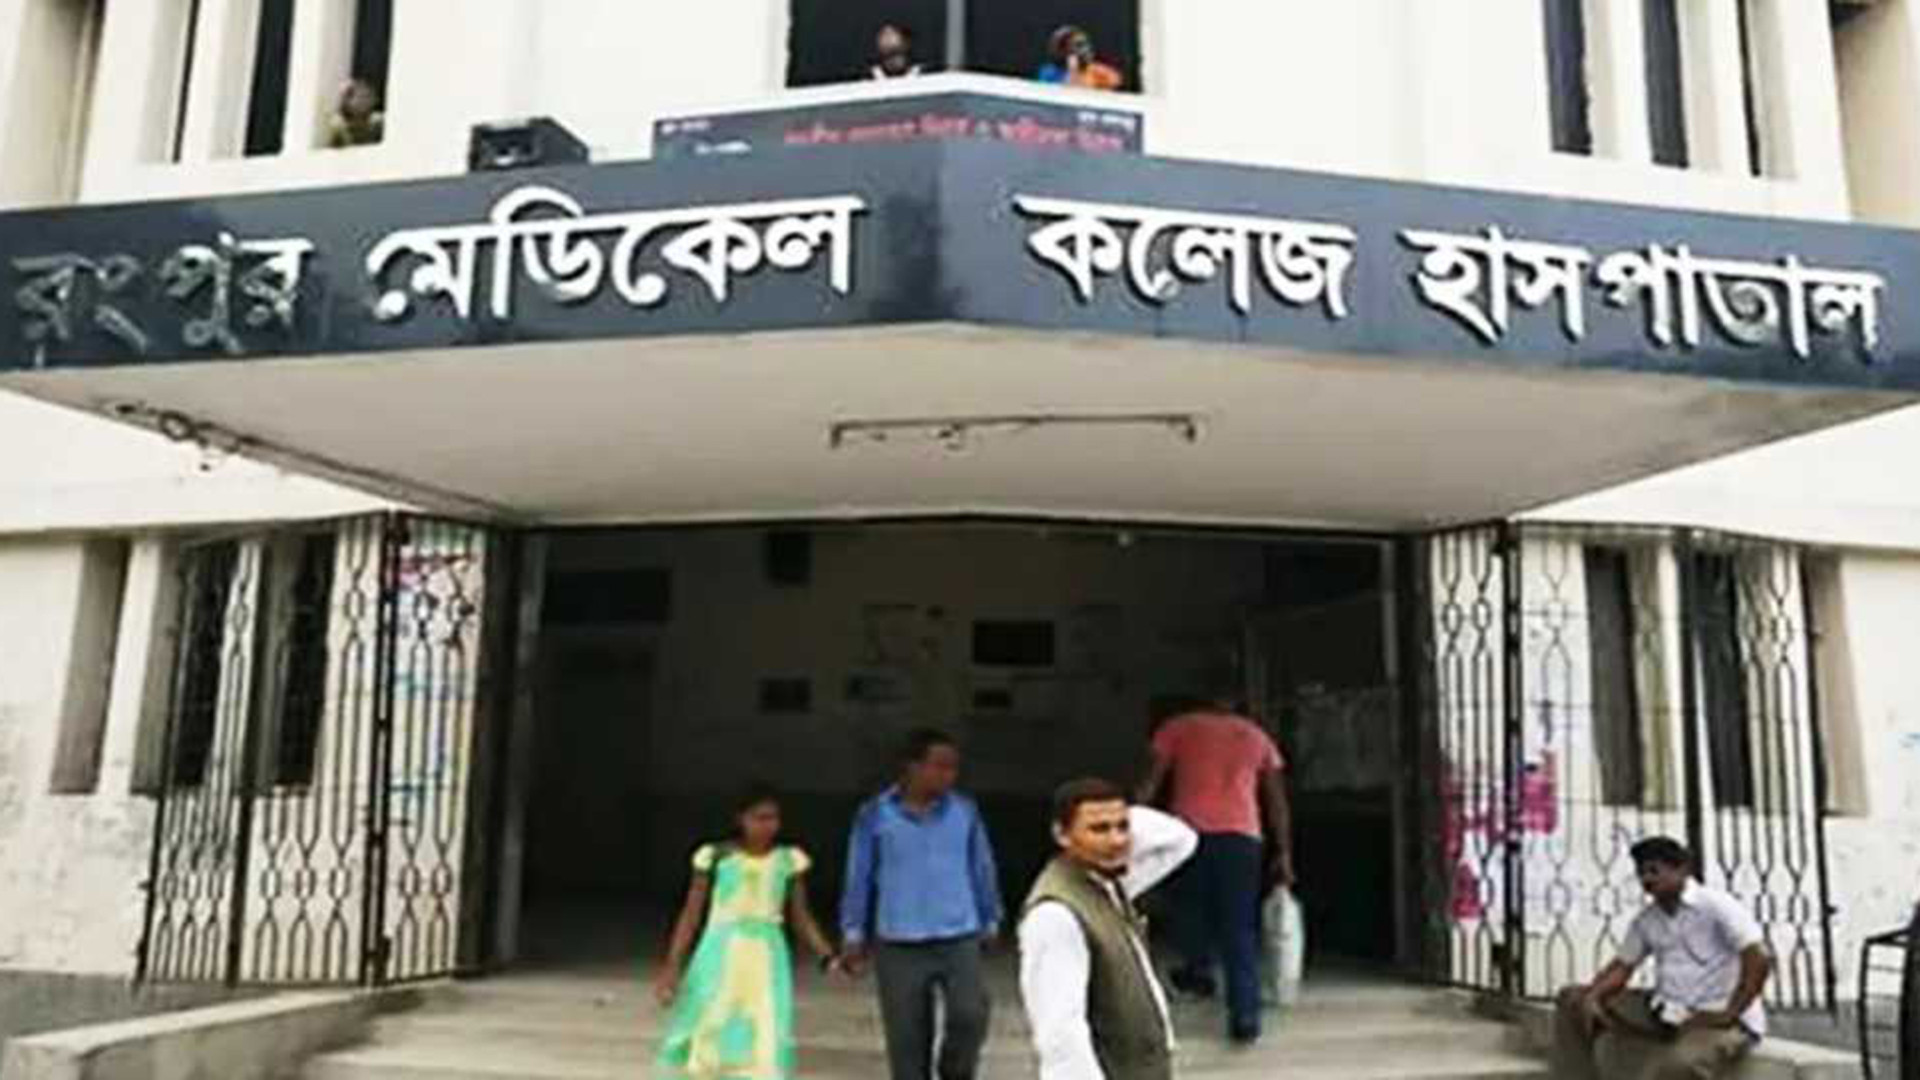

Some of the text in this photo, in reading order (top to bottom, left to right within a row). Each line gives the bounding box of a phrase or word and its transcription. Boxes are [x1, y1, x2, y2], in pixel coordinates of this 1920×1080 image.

[11, 186, 1886, 359] রংপুর মেডিকেল কলেজ হাসপাতাল
